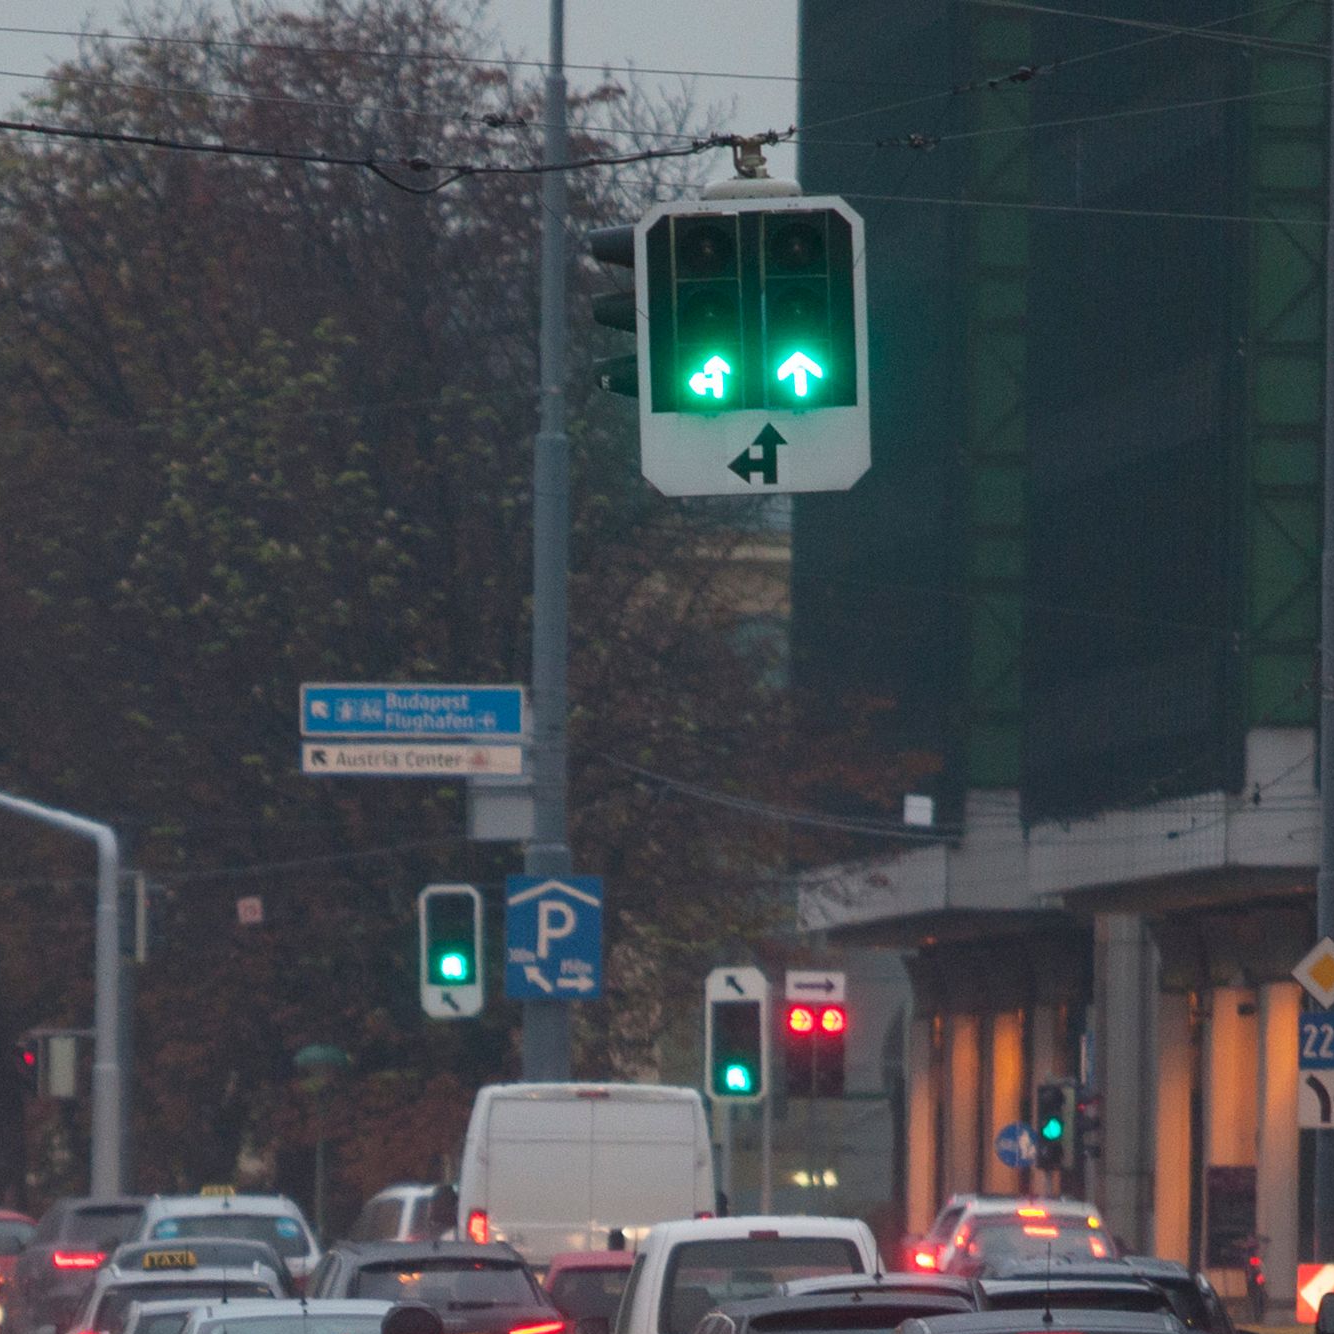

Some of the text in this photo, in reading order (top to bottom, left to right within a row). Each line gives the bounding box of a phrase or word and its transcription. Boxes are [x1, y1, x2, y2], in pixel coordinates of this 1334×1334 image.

[385, 691, 469, 711] Budapest
[336, 752, 461, 767] Austria Center
[537, 900, 575, 959] P
